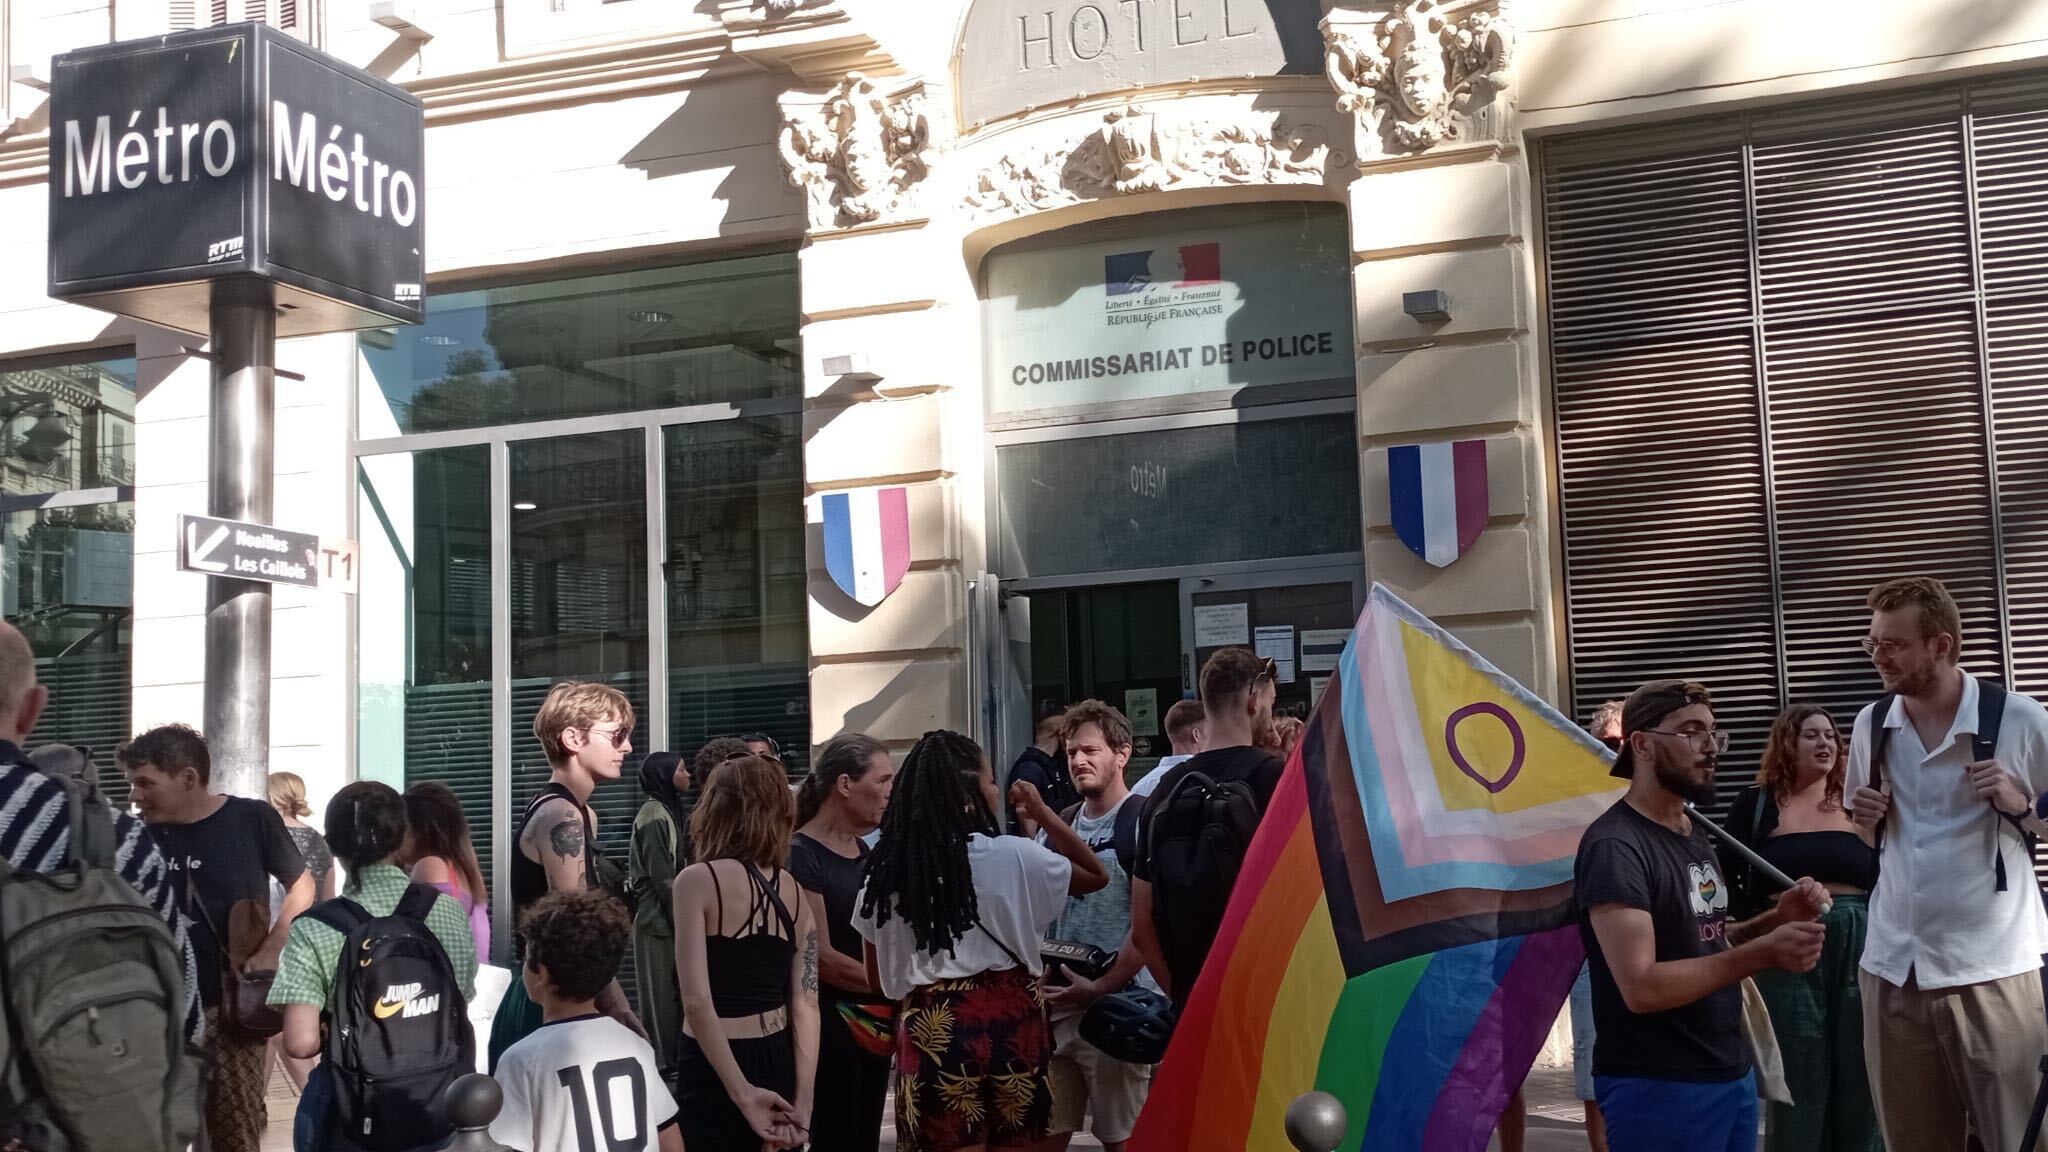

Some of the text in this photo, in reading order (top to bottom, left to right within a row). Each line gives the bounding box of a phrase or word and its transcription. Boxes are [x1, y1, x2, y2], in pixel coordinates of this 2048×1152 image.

[63, 107, 236, 197] Métro
[272, 99, 416, 227] Métro
[1105, 289, 1221, 310] Liberté Égalité Fraternité
[1107, 304, 1223, 329] RÉPUBLIQUE FRANÇAISE
[1012, 332, 1333, 386] COMMISSARIAT DE POLICE
[234, 529, 288, 553] Noailles
[234, 554, 258, 573] Les
[321, 548, 352, 581] T1
[381, 982, 425, 1004] JUMP
[401, 993, 440, 1019] MAN
[556, 1056, 648, 1152] 10
